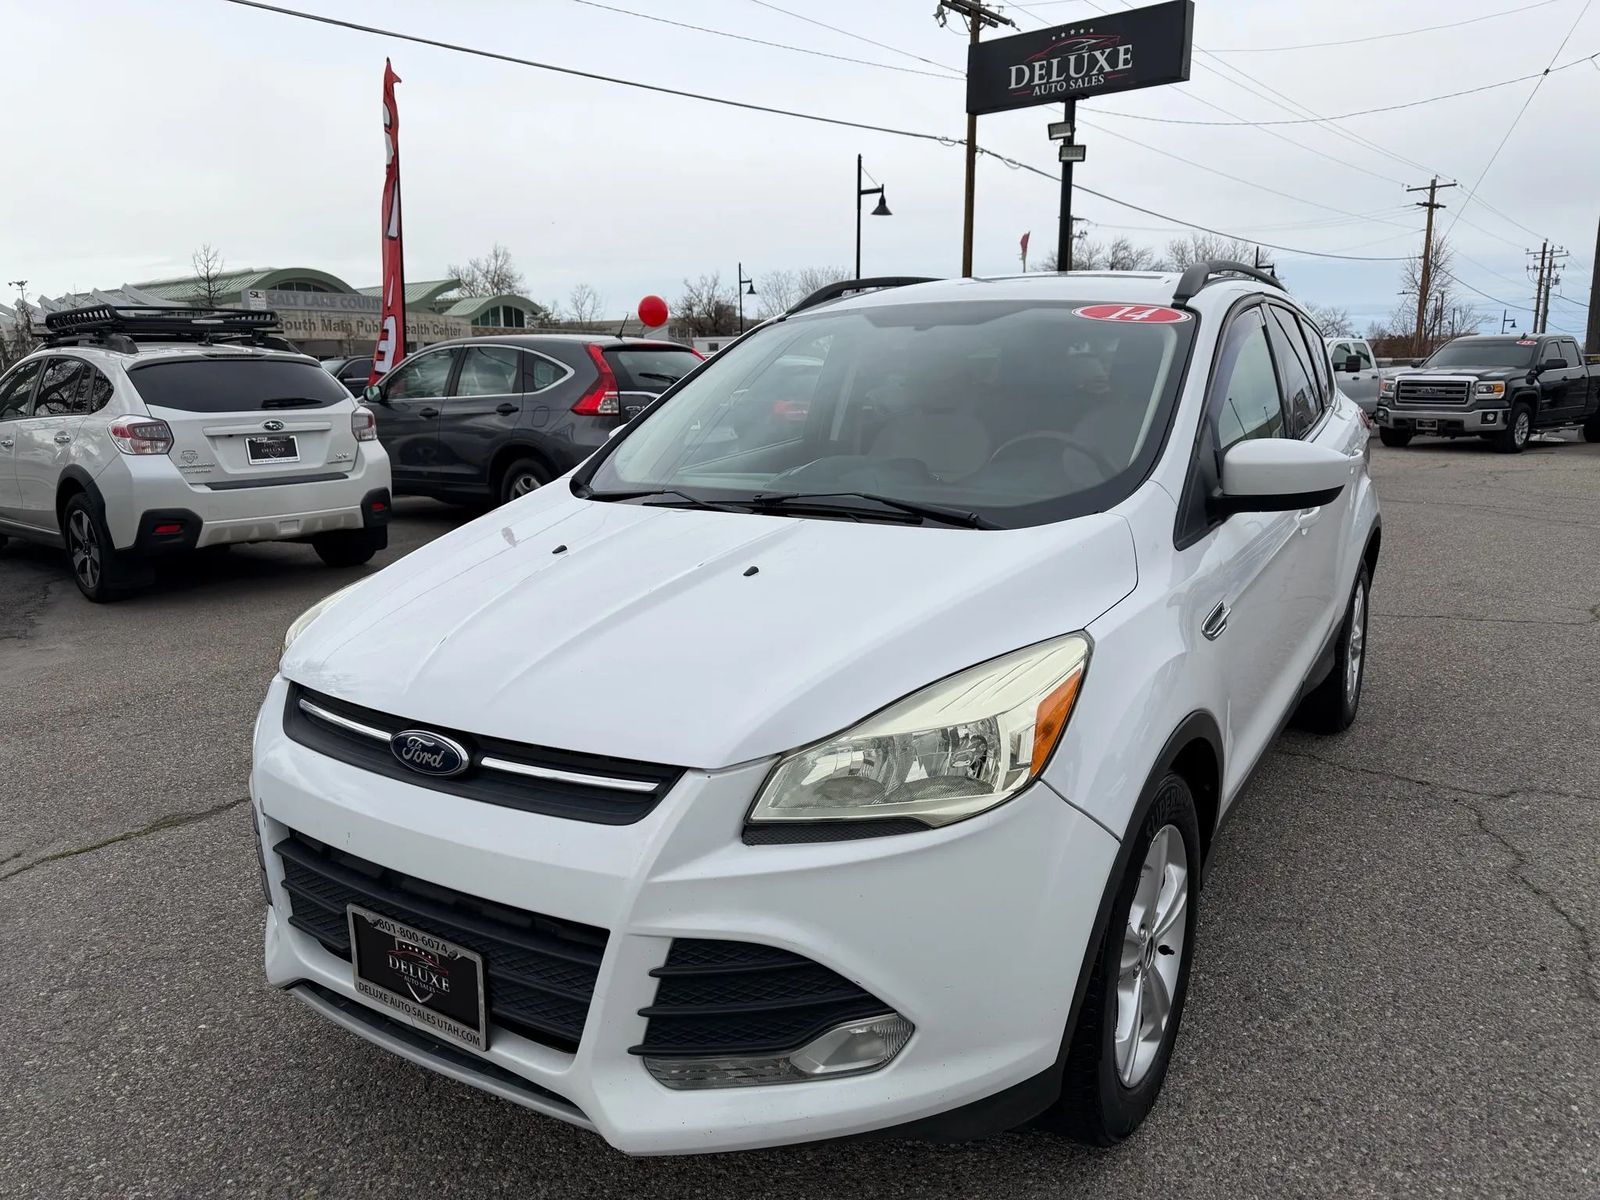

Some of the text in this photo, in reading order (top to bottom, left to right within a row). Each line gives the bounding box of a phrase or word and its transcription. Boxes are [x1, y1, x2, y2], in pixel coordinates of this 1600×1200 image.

[1008, 44, 1134, 90] DELUXE
[1032, 74, 1105, 97] AUTO SALES
[267, 293, 298, 305] SALT
[303, 294, 337, 307] LAKE
[1102, 306, 1161, 320] 14
[321, 319, 352, 332] Main
[404, 323, 430, 336] ealth
[432, 323, 462, 337] Center
[402, 736, 445, 768] Ford
[388, 954, 451, 992] DELUXE
[358, 981, 481, 1046] DELUXE AUTO SALES UTAH.COM
